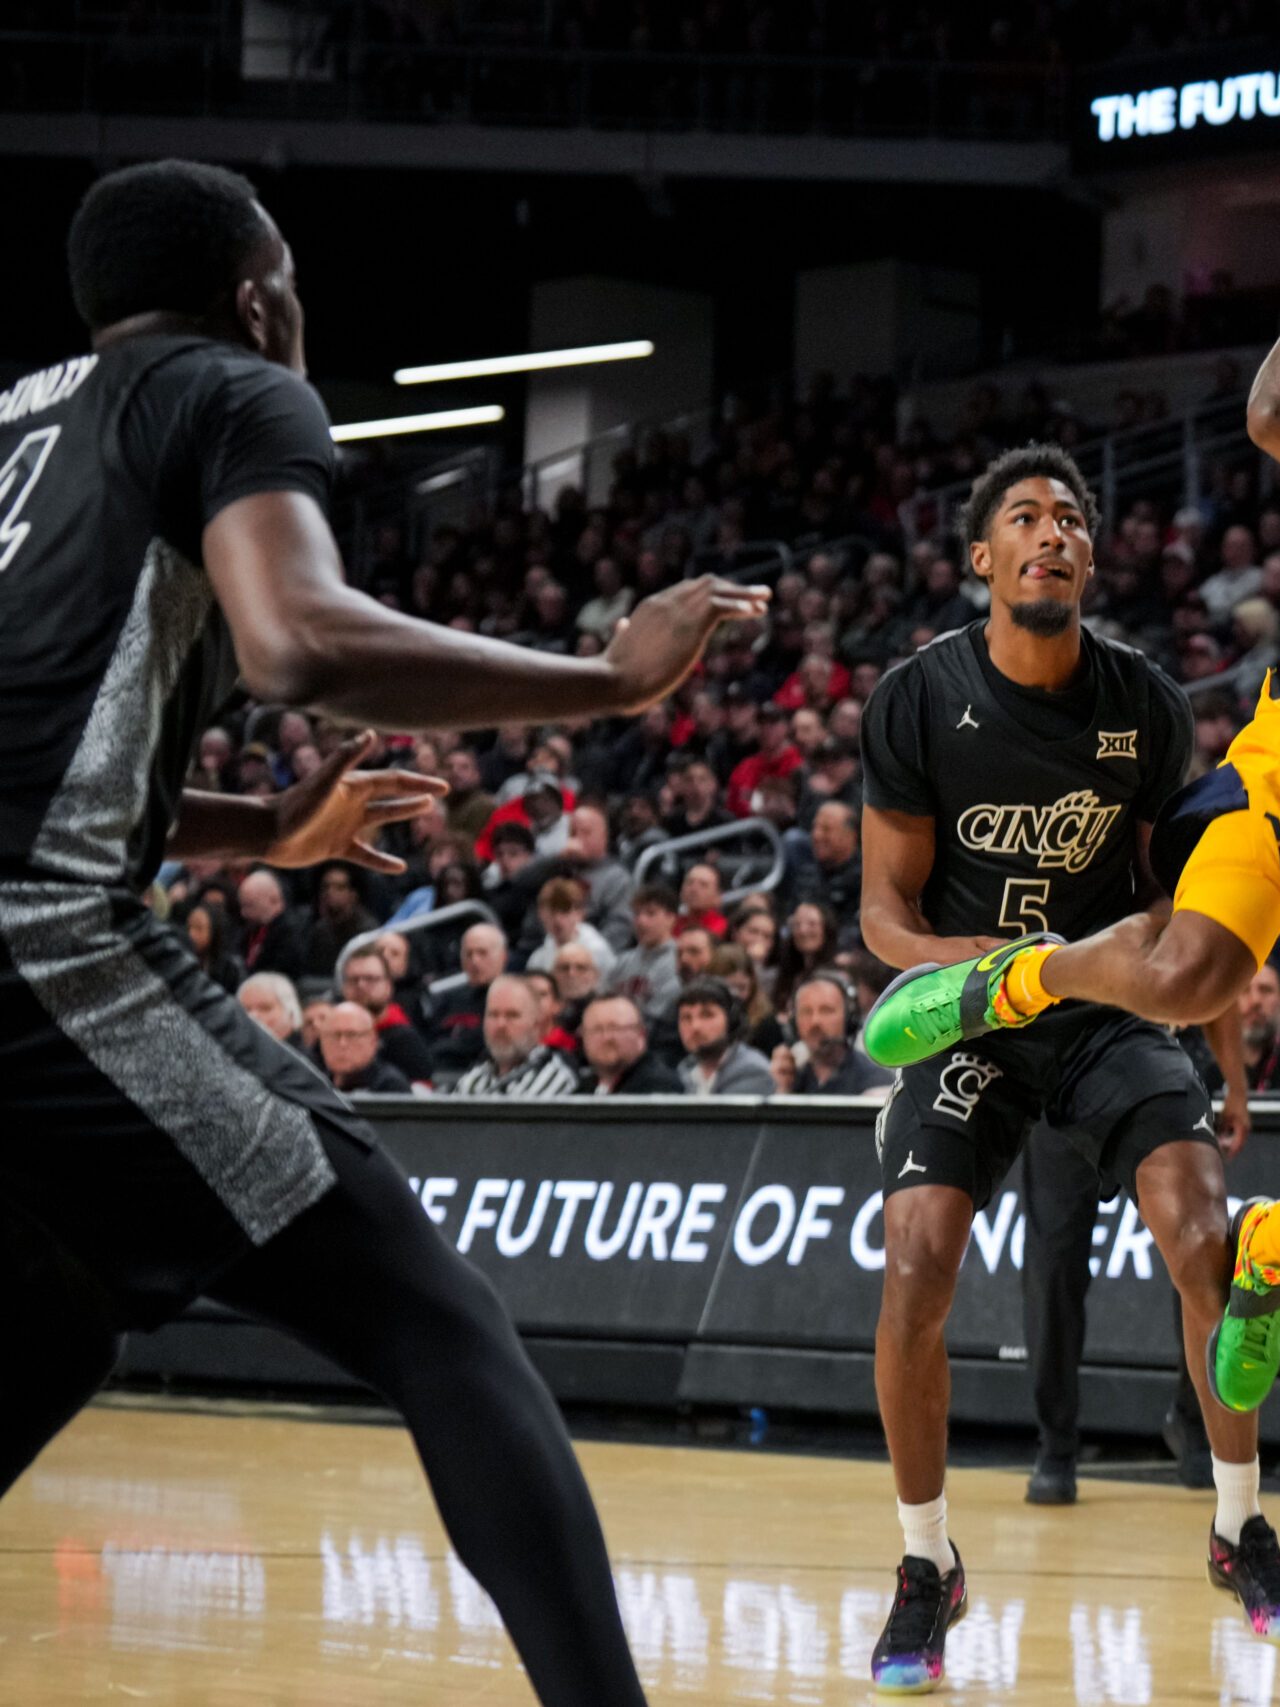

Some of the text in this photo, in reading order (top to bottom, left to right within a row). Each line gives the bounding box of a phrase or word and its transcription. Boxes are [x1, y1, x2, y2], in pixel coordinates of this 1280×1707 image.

[1091, 86, 1177, 141] THE
[998, 877, 1050, 936] 5
[456, 1178, 726, 1262] FUTURE
[733, 1185, 845, 1266] OF
